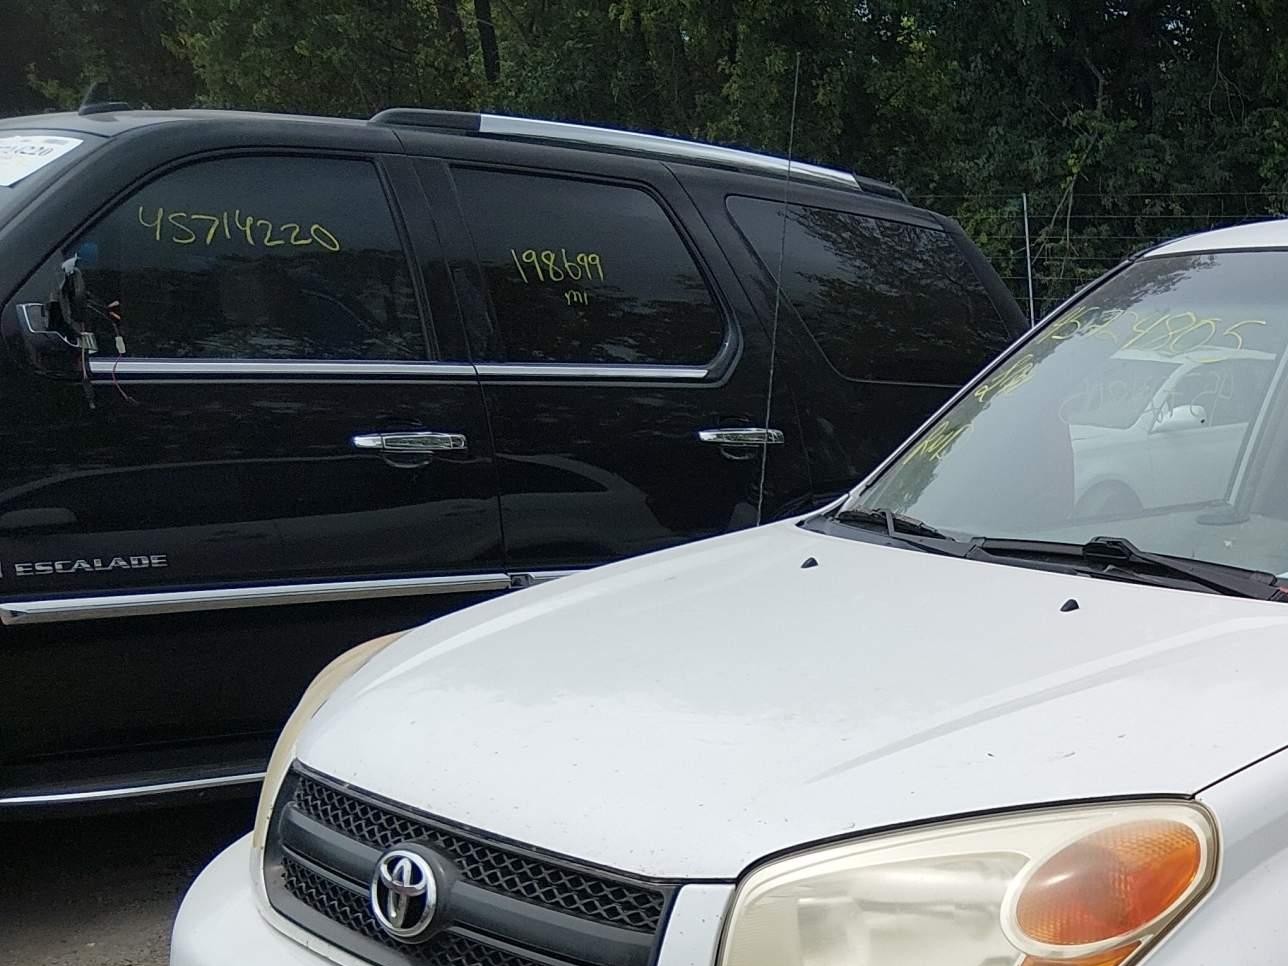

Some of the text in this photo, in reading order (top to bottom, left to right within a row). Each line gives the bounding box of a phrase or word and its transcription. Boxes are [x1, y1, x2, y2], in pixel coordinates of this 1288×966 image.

[138, 206, 340, 252] 45714220
[510, 248, 604, 283] 198699
[15, 555, 168, 576] ESCALADE
